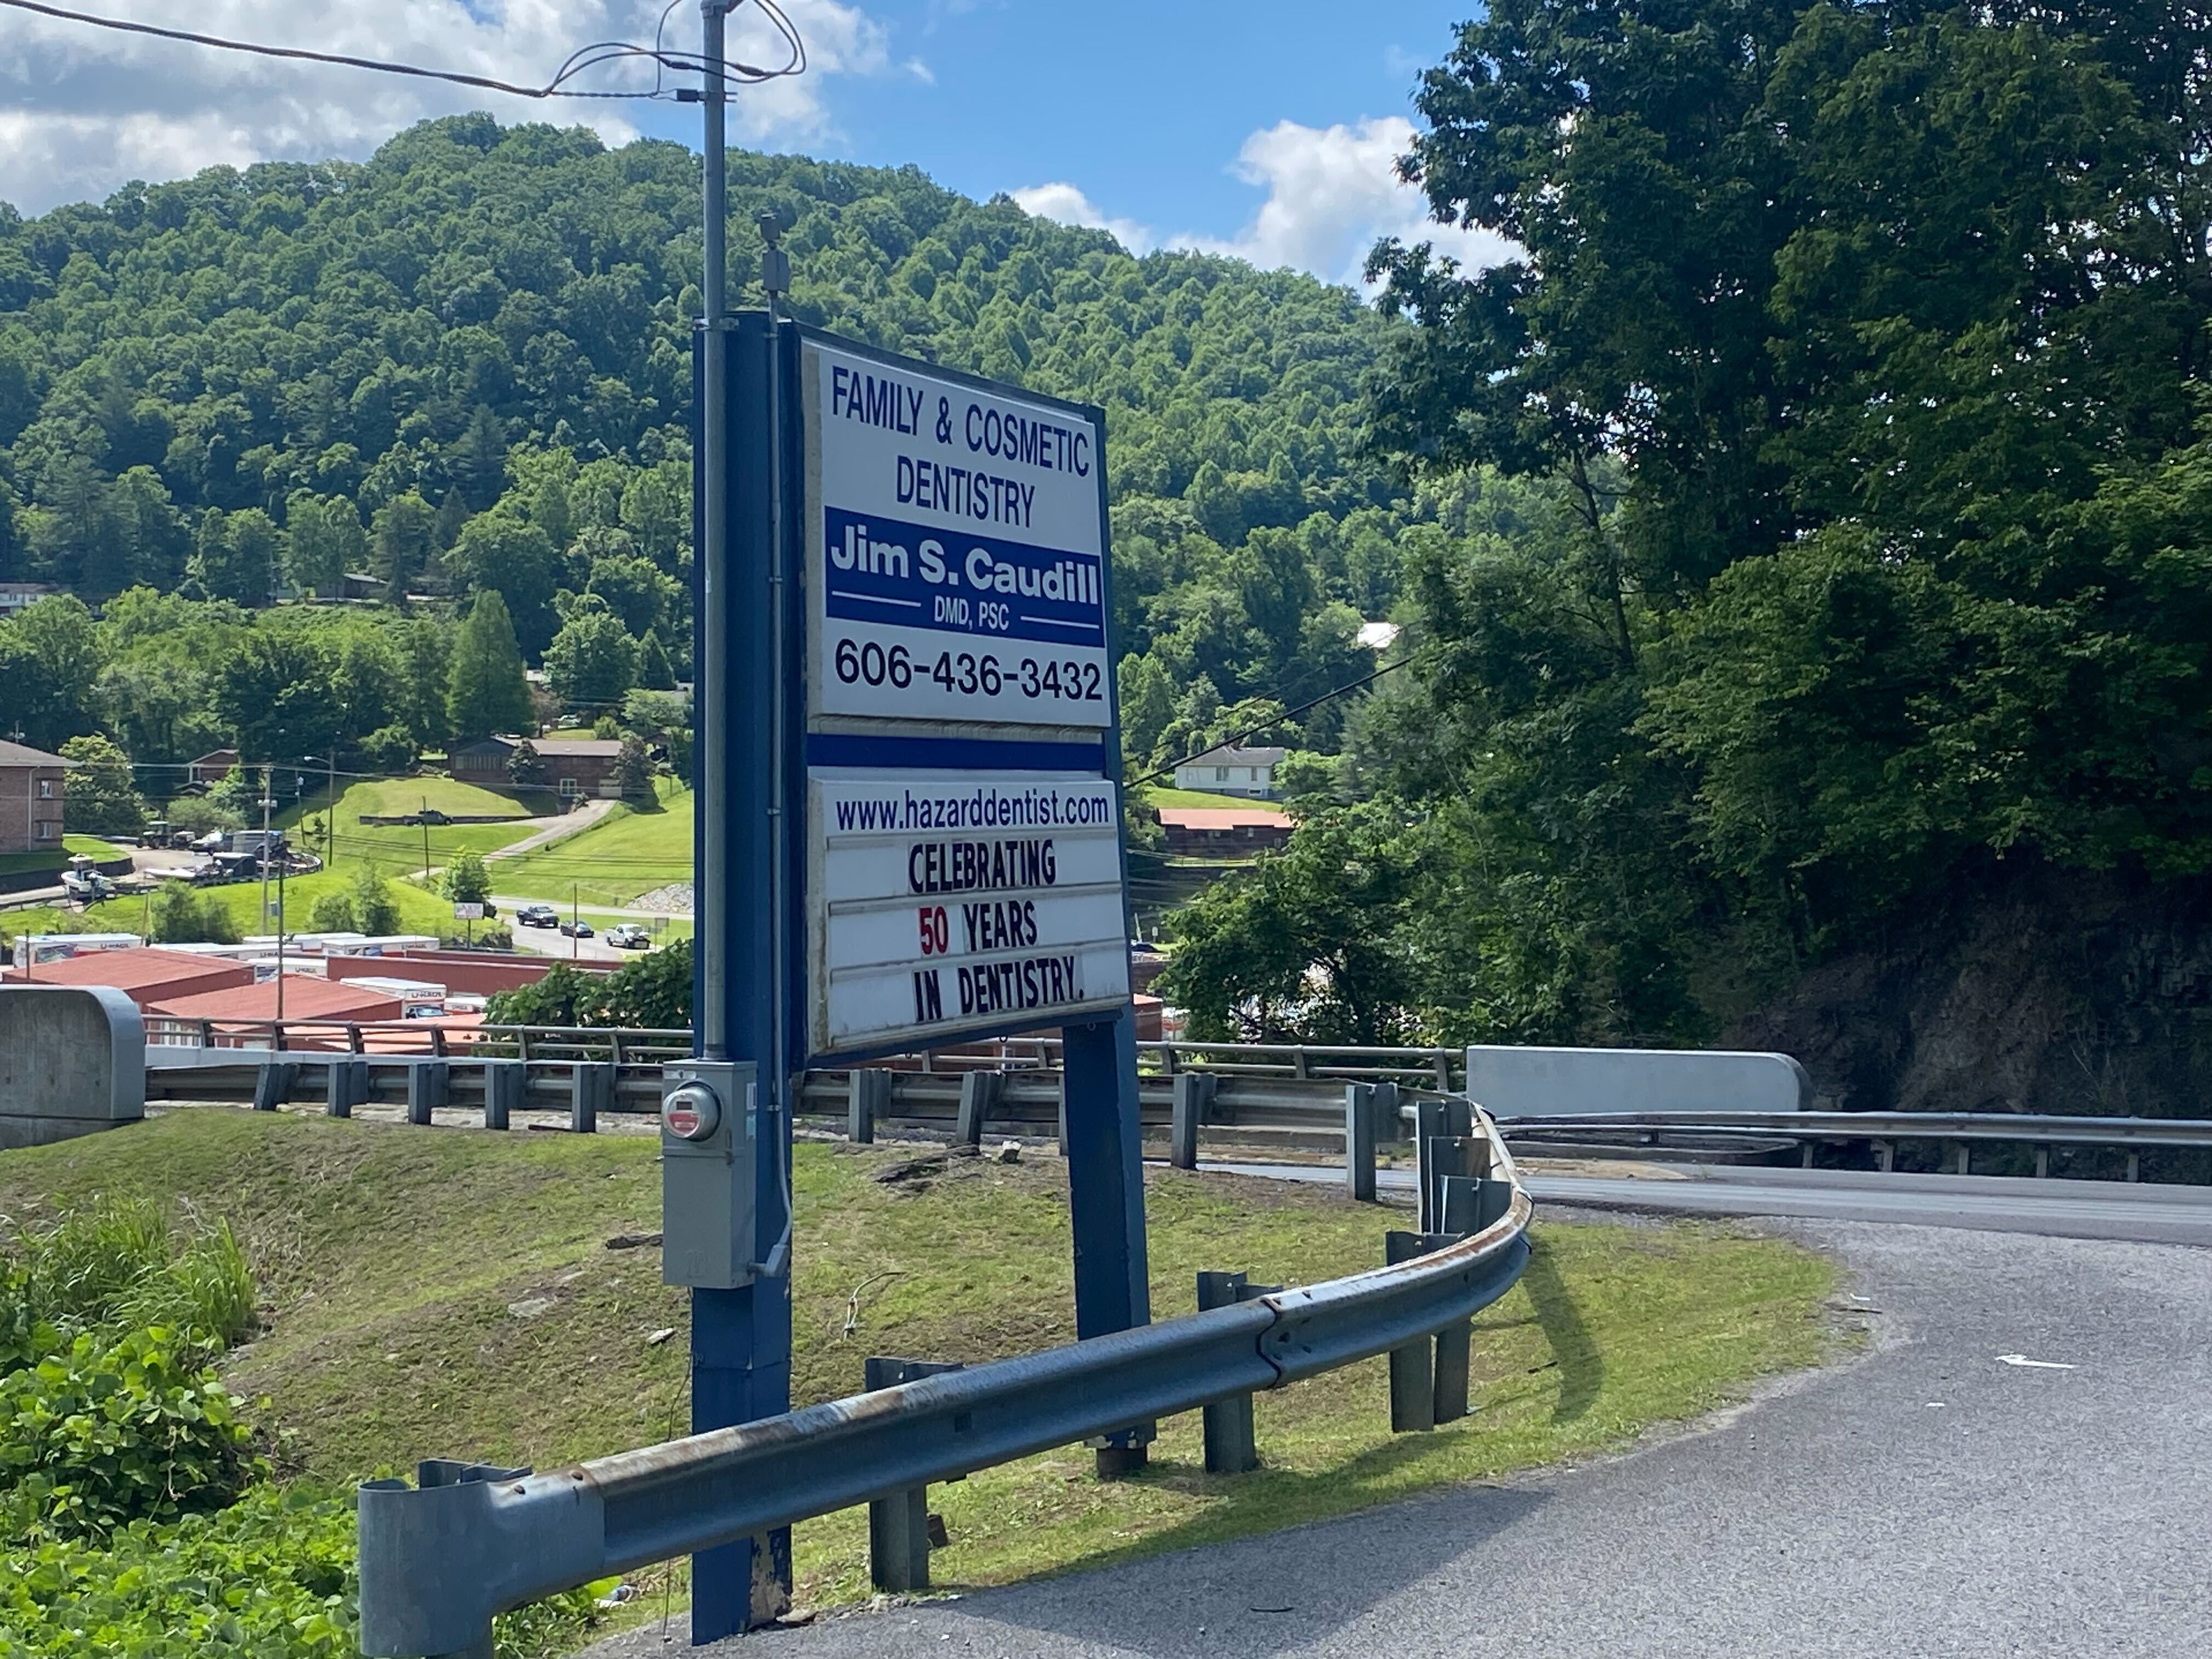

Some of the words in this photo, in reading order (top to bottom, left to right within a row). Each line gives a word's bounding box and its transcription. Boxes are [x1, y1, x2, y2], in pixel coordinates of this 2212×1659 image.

[832, 365, 924, 436] FAMILY
[935, 396, 953, 445] &
[965, 404, 1090, 477] COSMETIC
[896, 455, 1035, 528] DENTISTRY
[831, 524, 909, 579] Jim
[918, 540, 959, 585] S.
[965, 548, 1098, 605] Caudill
[934, 595, 973, 630] DMD,
[979, 601, 1010, 630] PSC
[835, 639, 1103, 701] 606-436-3432
[836, 788, 1109, 831] www.hazarddentist.com
[909, 839, 1057, 894] CELEBRATING
[918, 906, 948, 955] 50
[962, 900, 1038, 952] YEARS
[914, 969, 943, 1023] IN
[958, 956, 1085, 1014] DENTISTRY.
